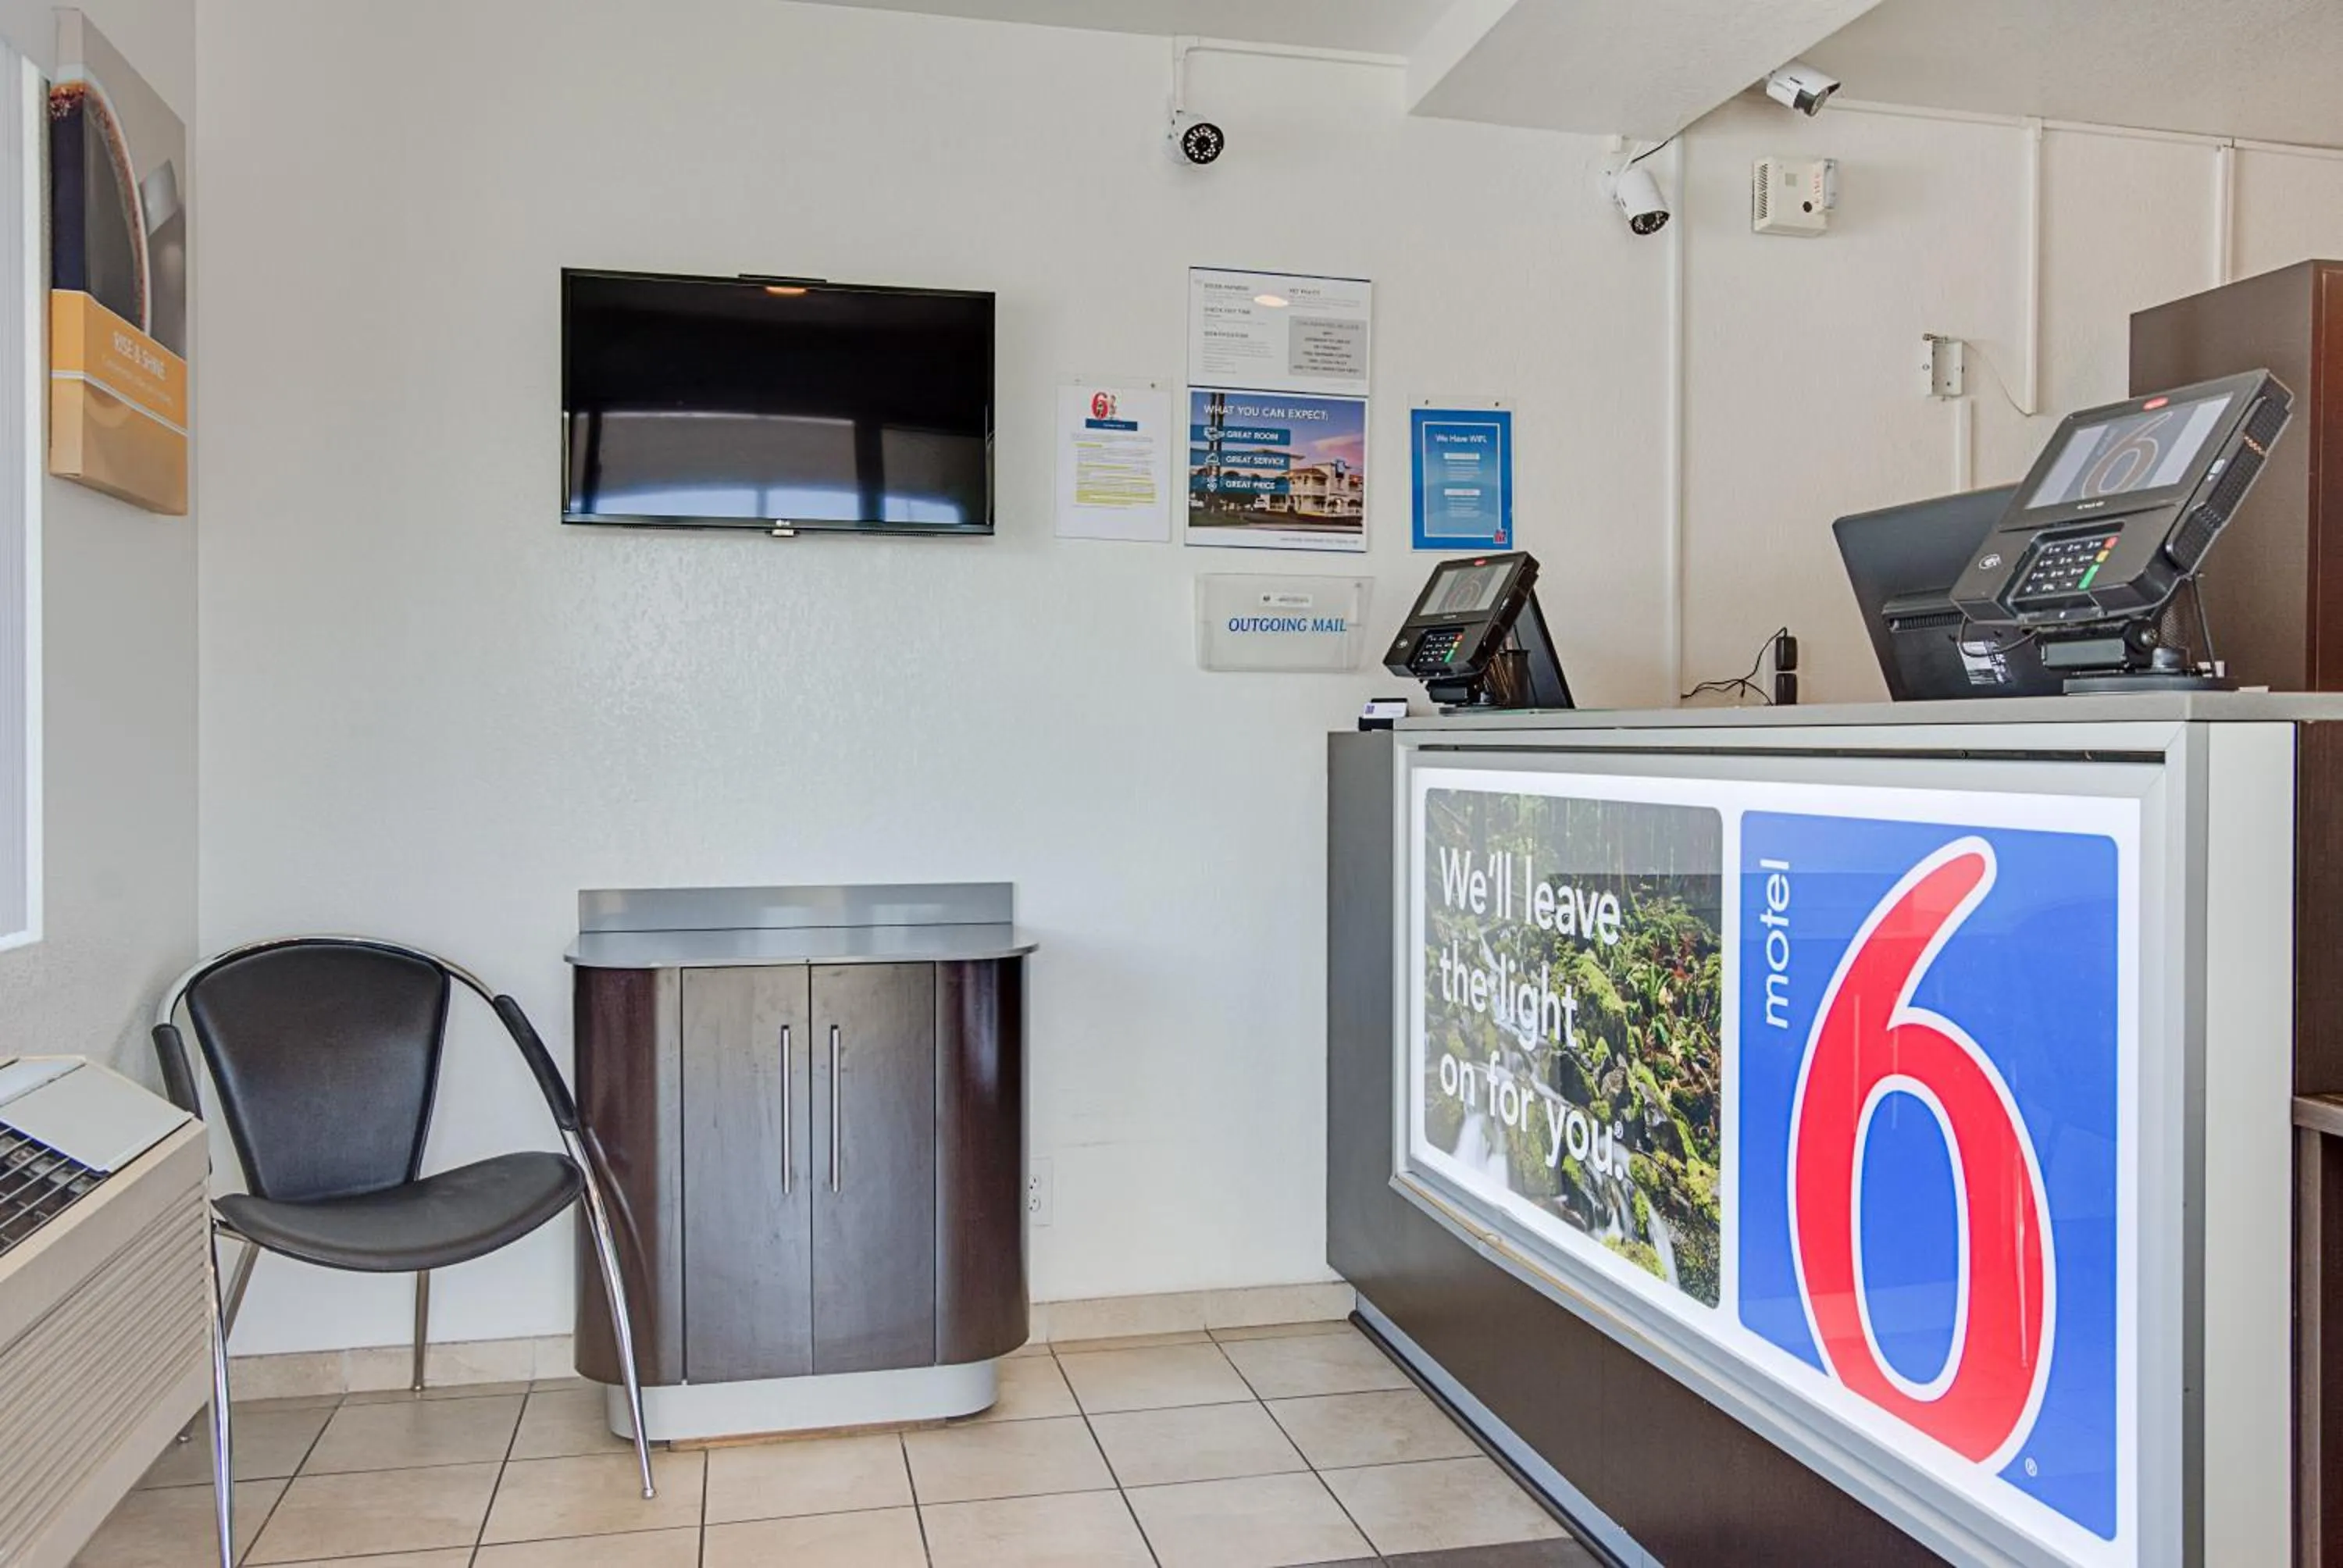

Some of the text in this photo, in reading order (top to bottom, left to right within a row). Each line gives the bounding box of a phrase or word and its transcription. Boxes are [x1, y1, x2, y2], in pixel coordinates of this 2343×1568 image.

[1204, 404, 1235, 415] WHAT
[1238, 407, 1260, 417] YOU
[1262, 408, 1286, 418] CAN
[1226, 430, 1278, 441] GREAT ROOM
[1225, 455, 1251, 464] GREAT
[1229, 617, 1347, 633] OUTGOING MAIL
[1439, 846, 1621, 946] We'll leave
[1760, 858, 1790, 1029] motel
[1440, 940, 1578, 1051] the light
[1440, 1053, 1475, 1107] on
[1487, 1051, 1534, 1131] for
[1787, 835, 2057, 1475] 6
